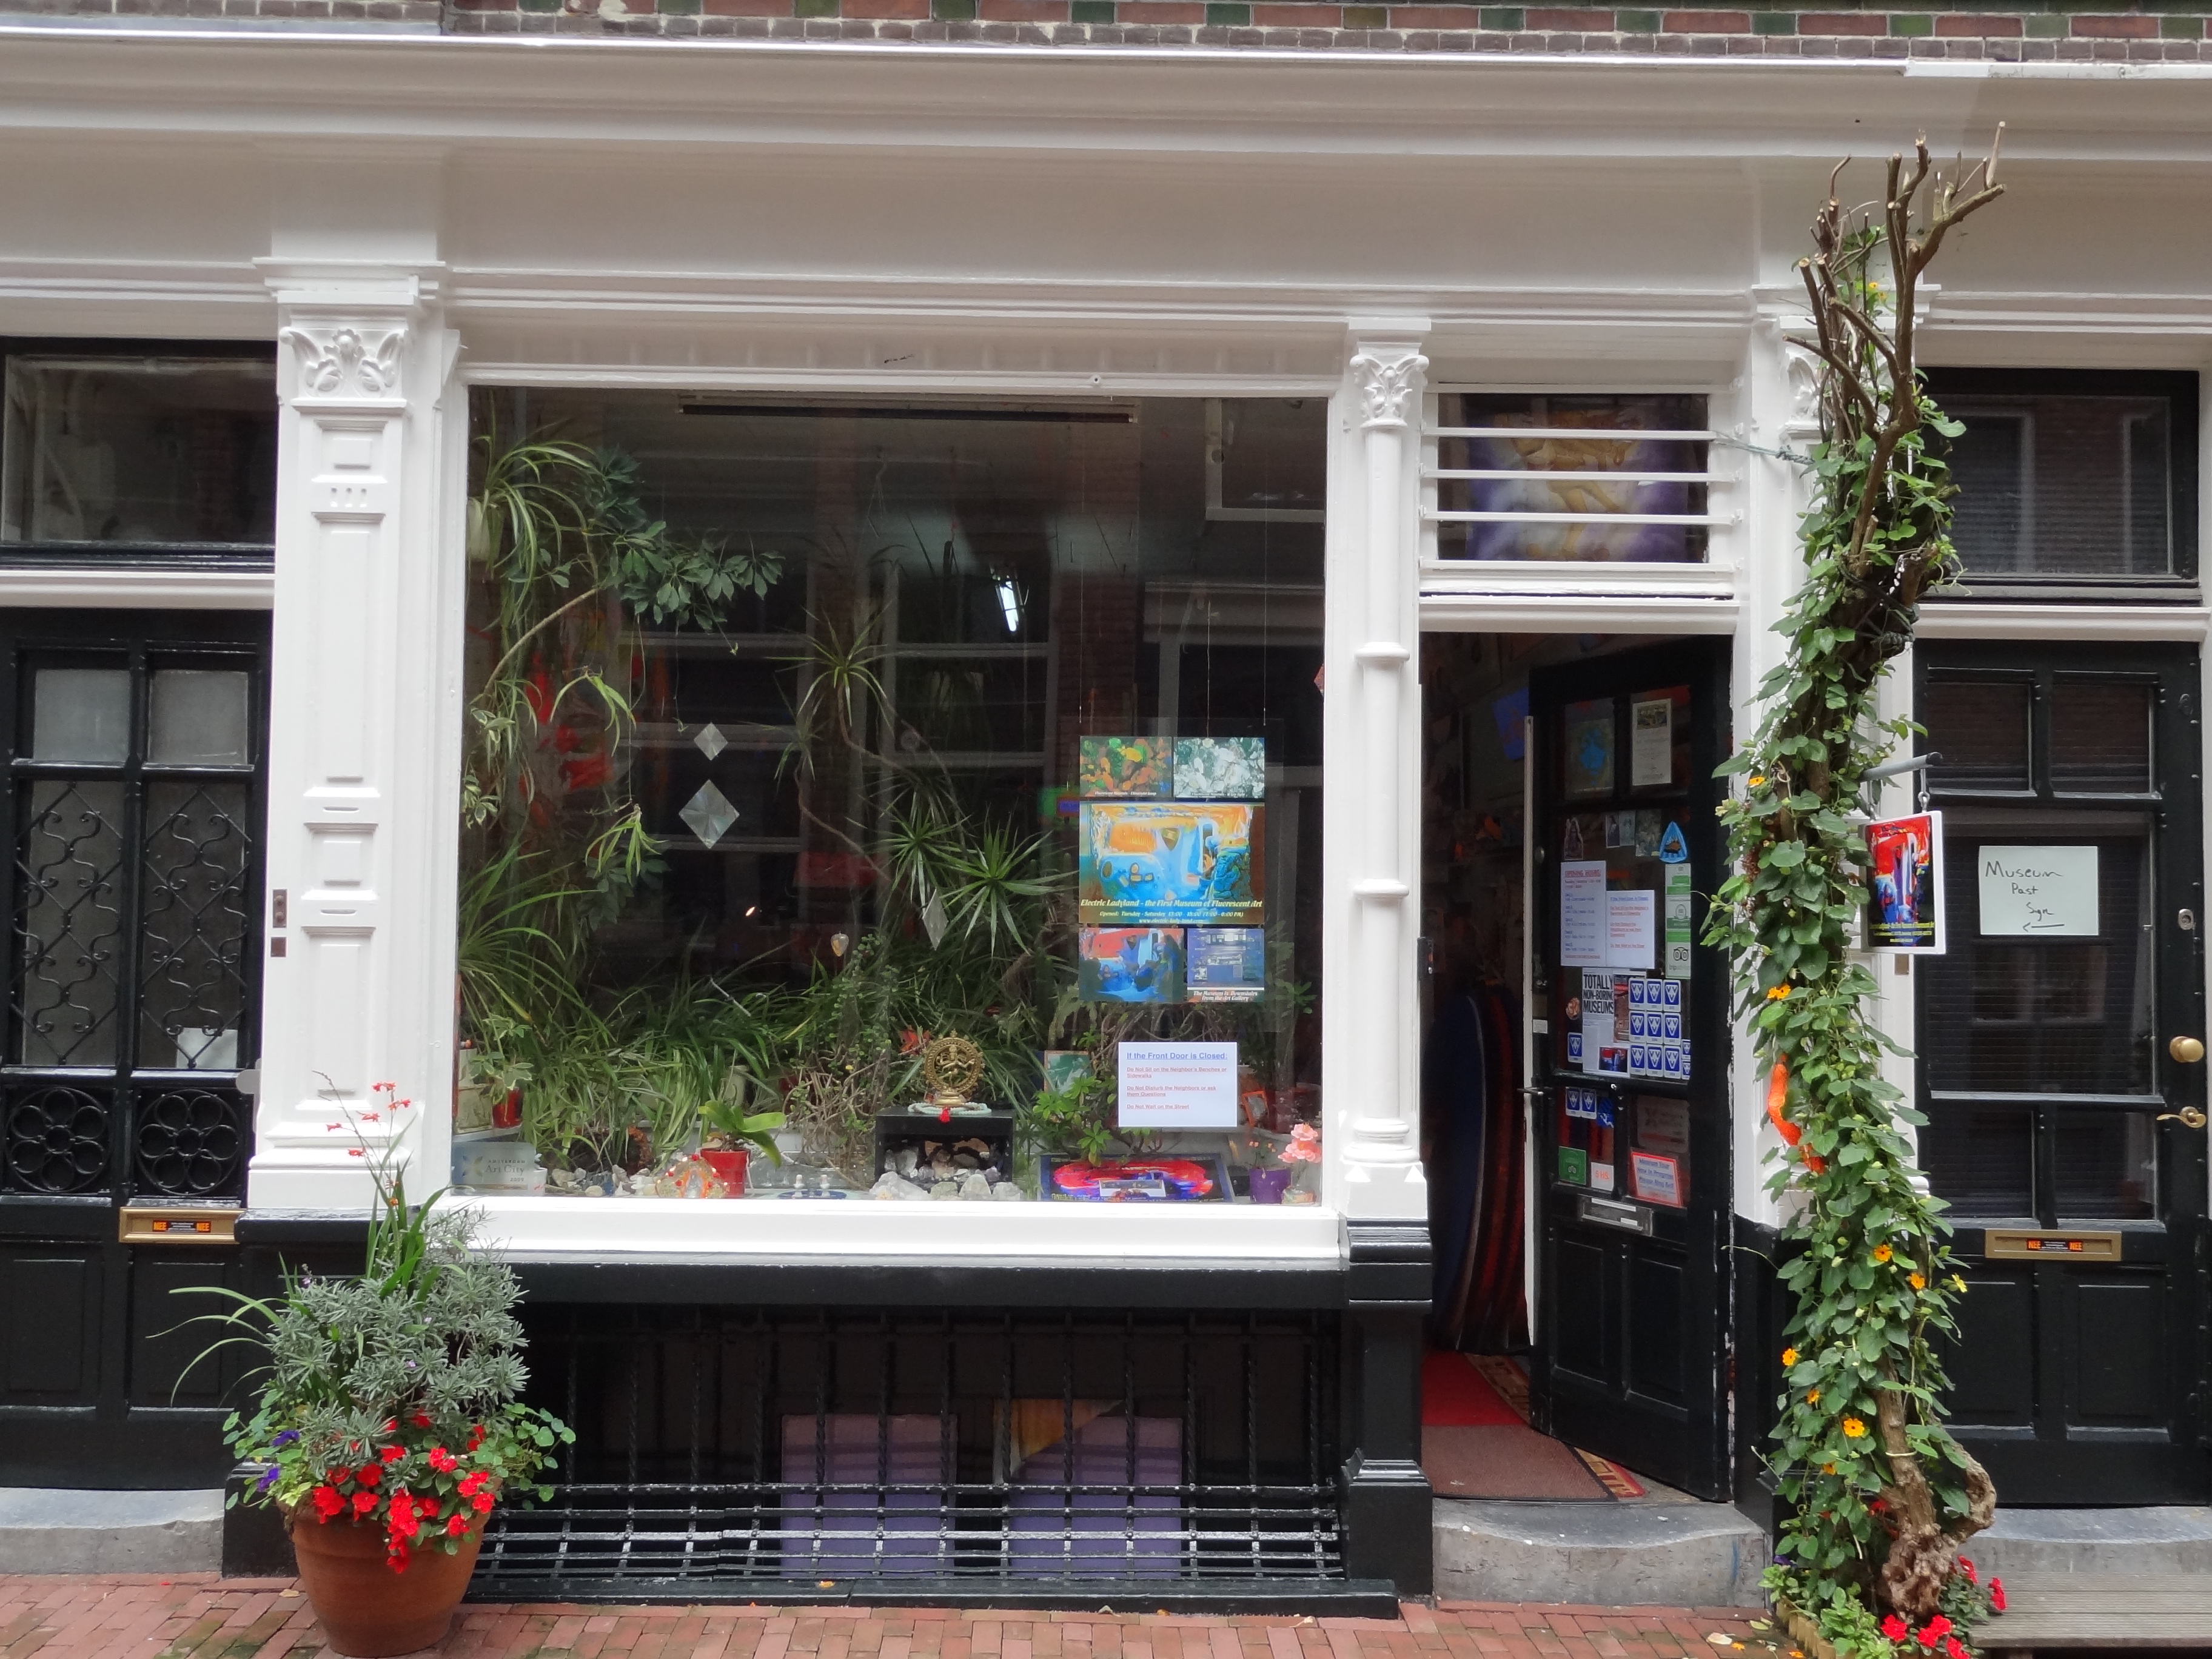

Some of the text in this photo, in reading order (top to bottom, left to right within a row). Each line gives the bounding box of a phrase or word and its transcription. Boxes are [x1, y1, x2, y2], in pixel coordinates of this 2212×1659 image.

[1985, 860, 2063, 877] Museum
[2011, 882, 2039, 895] Past
[1583, 974, 1613, 990] TOTALLY
[1583, 1000, 1614, 1014] MUSEUMS
[486, 1165, 525, 1176] Art City
[153, 1222, 167, 1231] NEE
[196, 1222, 210, 1232] NEE
[2028, 1241, 2041, 1249] NEE
[2070, 1242, 2082, 1250] NEE
